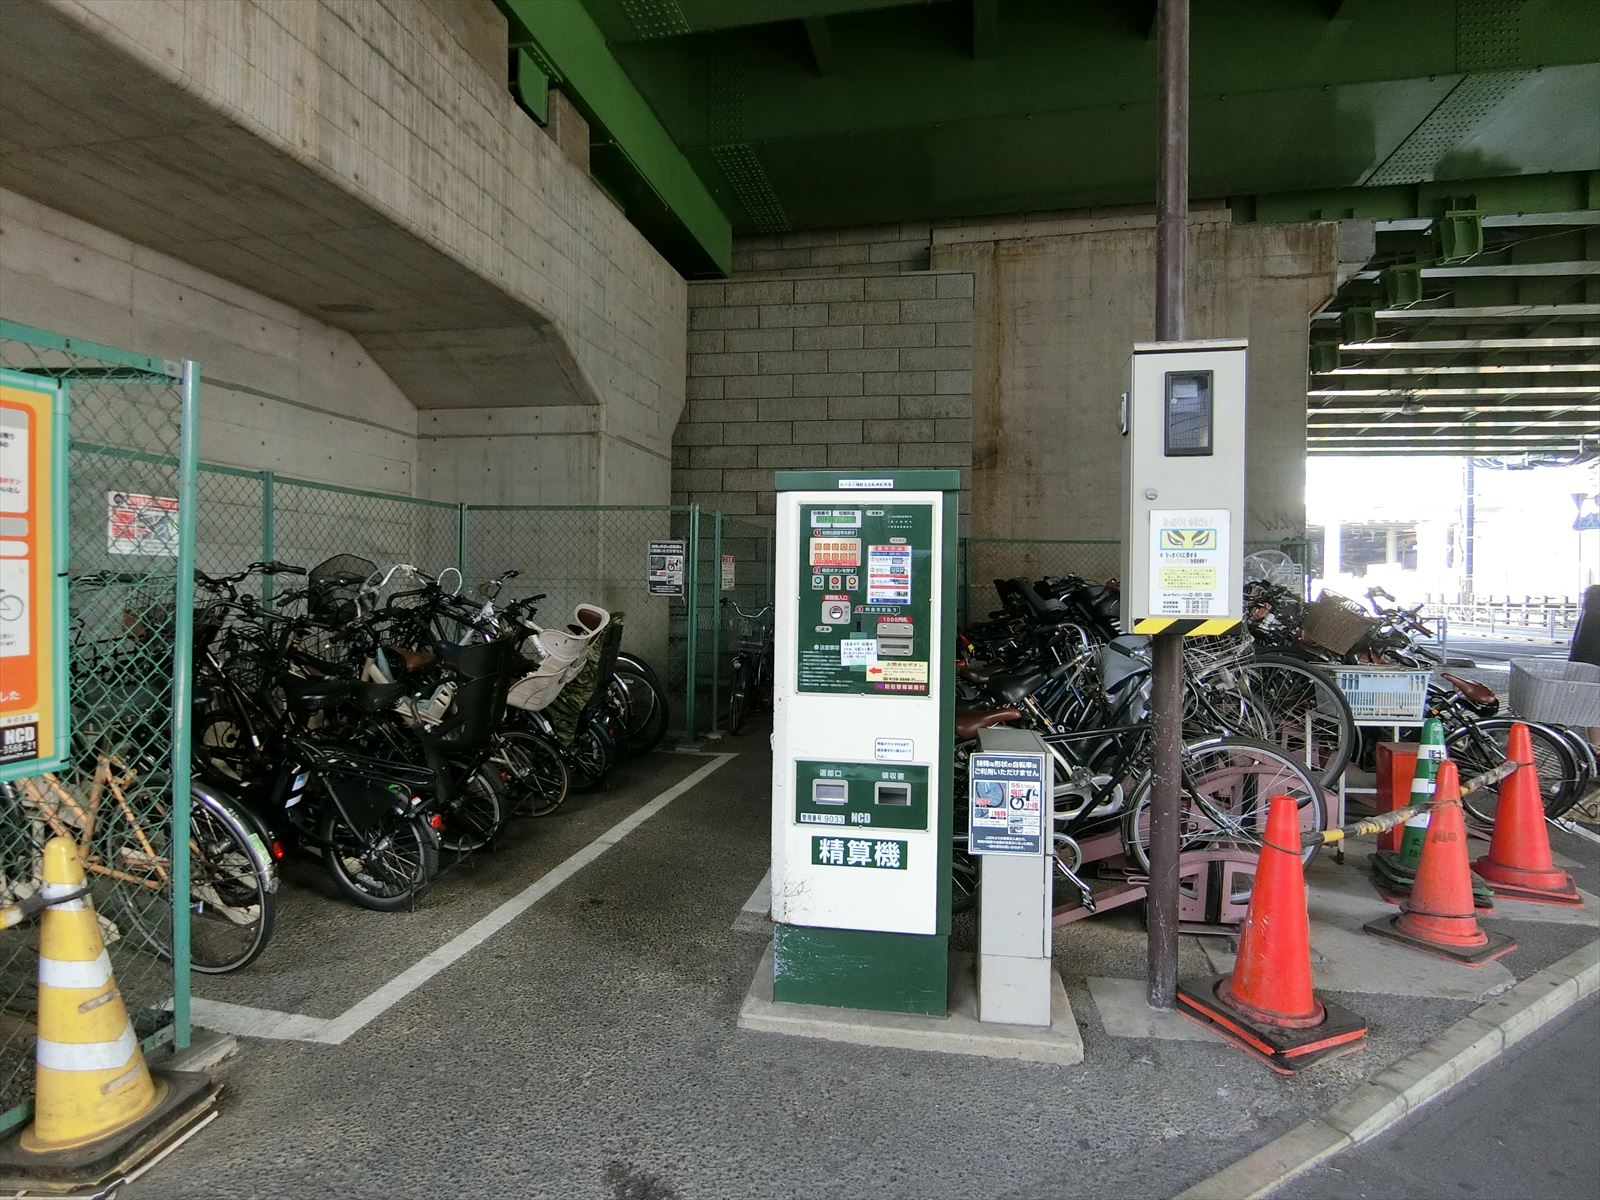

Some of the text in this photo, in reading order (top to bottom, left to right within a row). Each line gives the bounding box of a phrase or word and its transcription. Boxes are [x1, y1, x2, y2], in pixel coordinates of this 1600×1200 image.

[4, 726, 35, 746] NCD
[974, 768, 1039, 776] ご利用いただけません
[851, 812, 871, 824] NCD
[819, 838, 900, 868] 精算機
